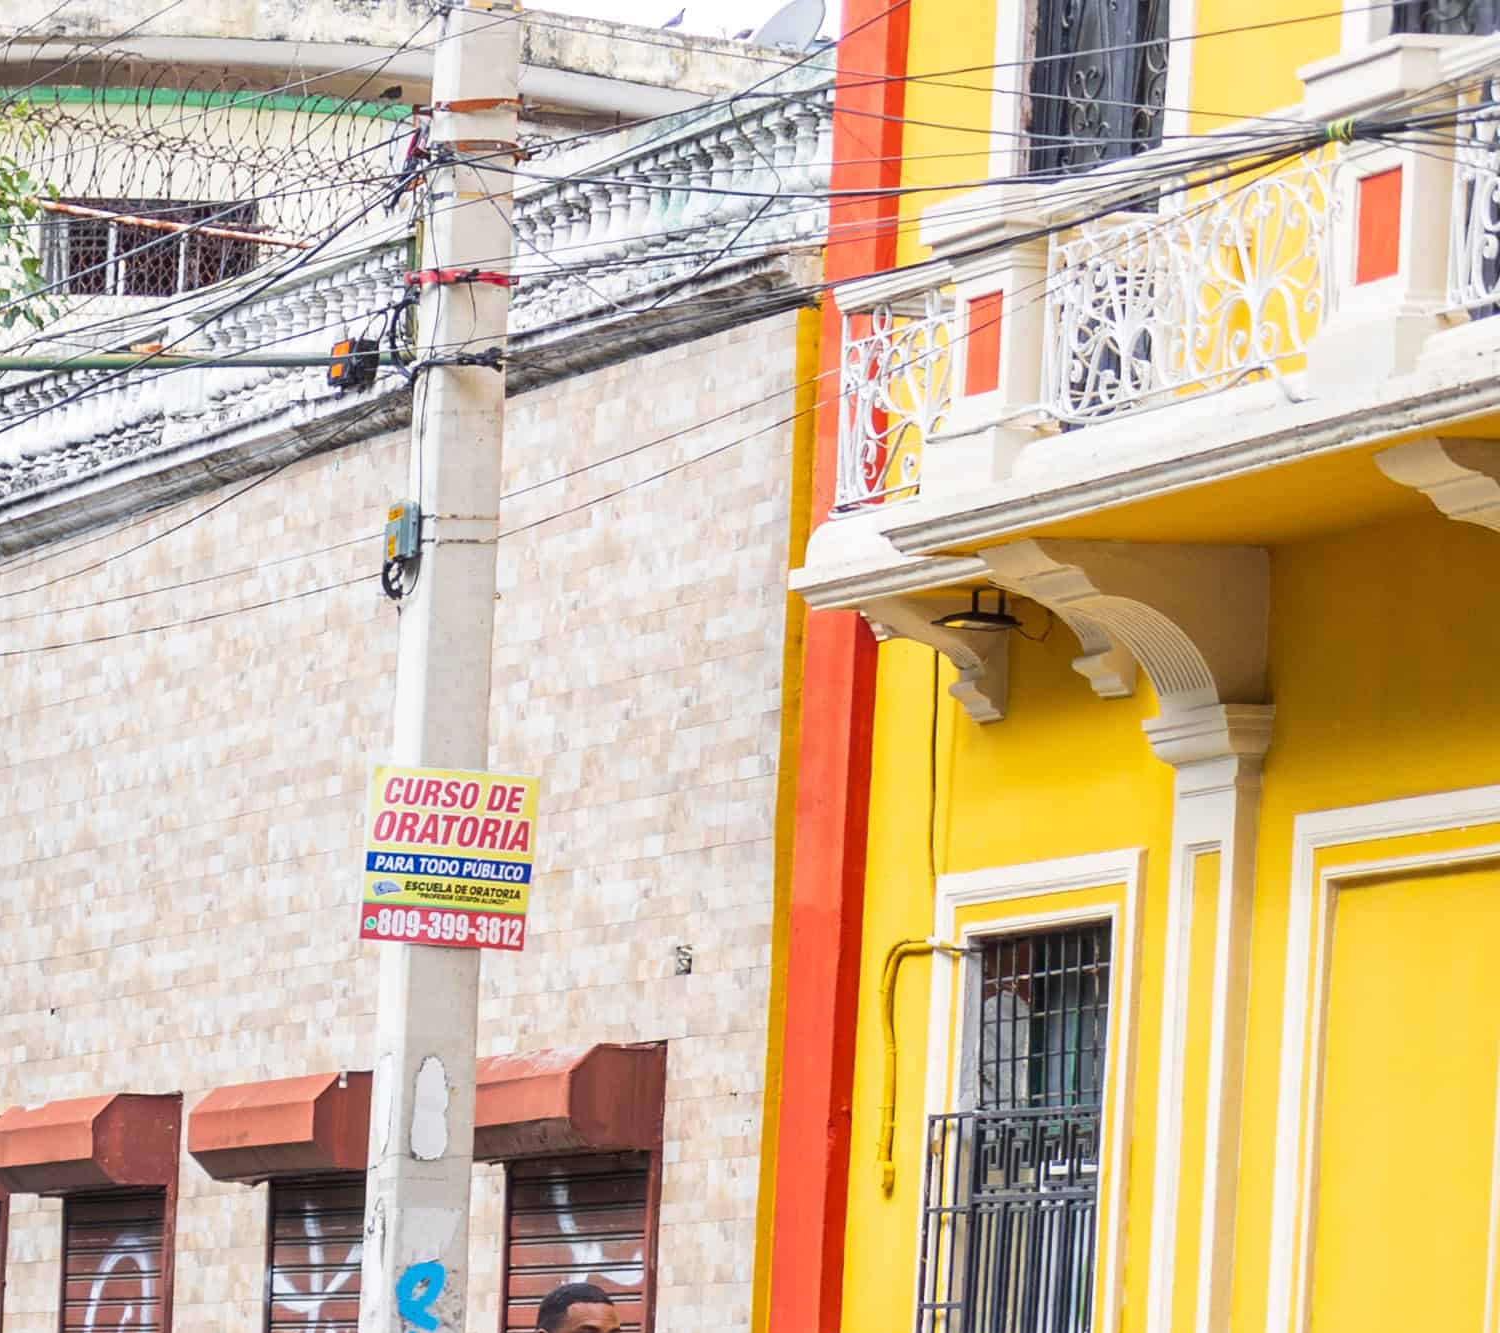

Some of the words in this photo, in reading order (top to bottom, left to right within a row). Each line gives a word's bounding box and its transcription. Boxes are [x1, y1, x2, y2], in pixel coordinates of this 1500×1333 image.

[384, 778, 479, 809] CURSO
[486, 785, 525, 814] DE
[372, 811, 530, 852] ORATORIA
[374, 856, 414, 873] PARA
[419, 858, 459, 877] TODO
[462, 858, 524, 881] PÚBLICO
[404, 881, 452, 893] ESCUELA
[454, 885, 468, 895] DE
[469, 886, 521, 900] ORATORIA
[376, 908, 522, 946] 809-399-3812
